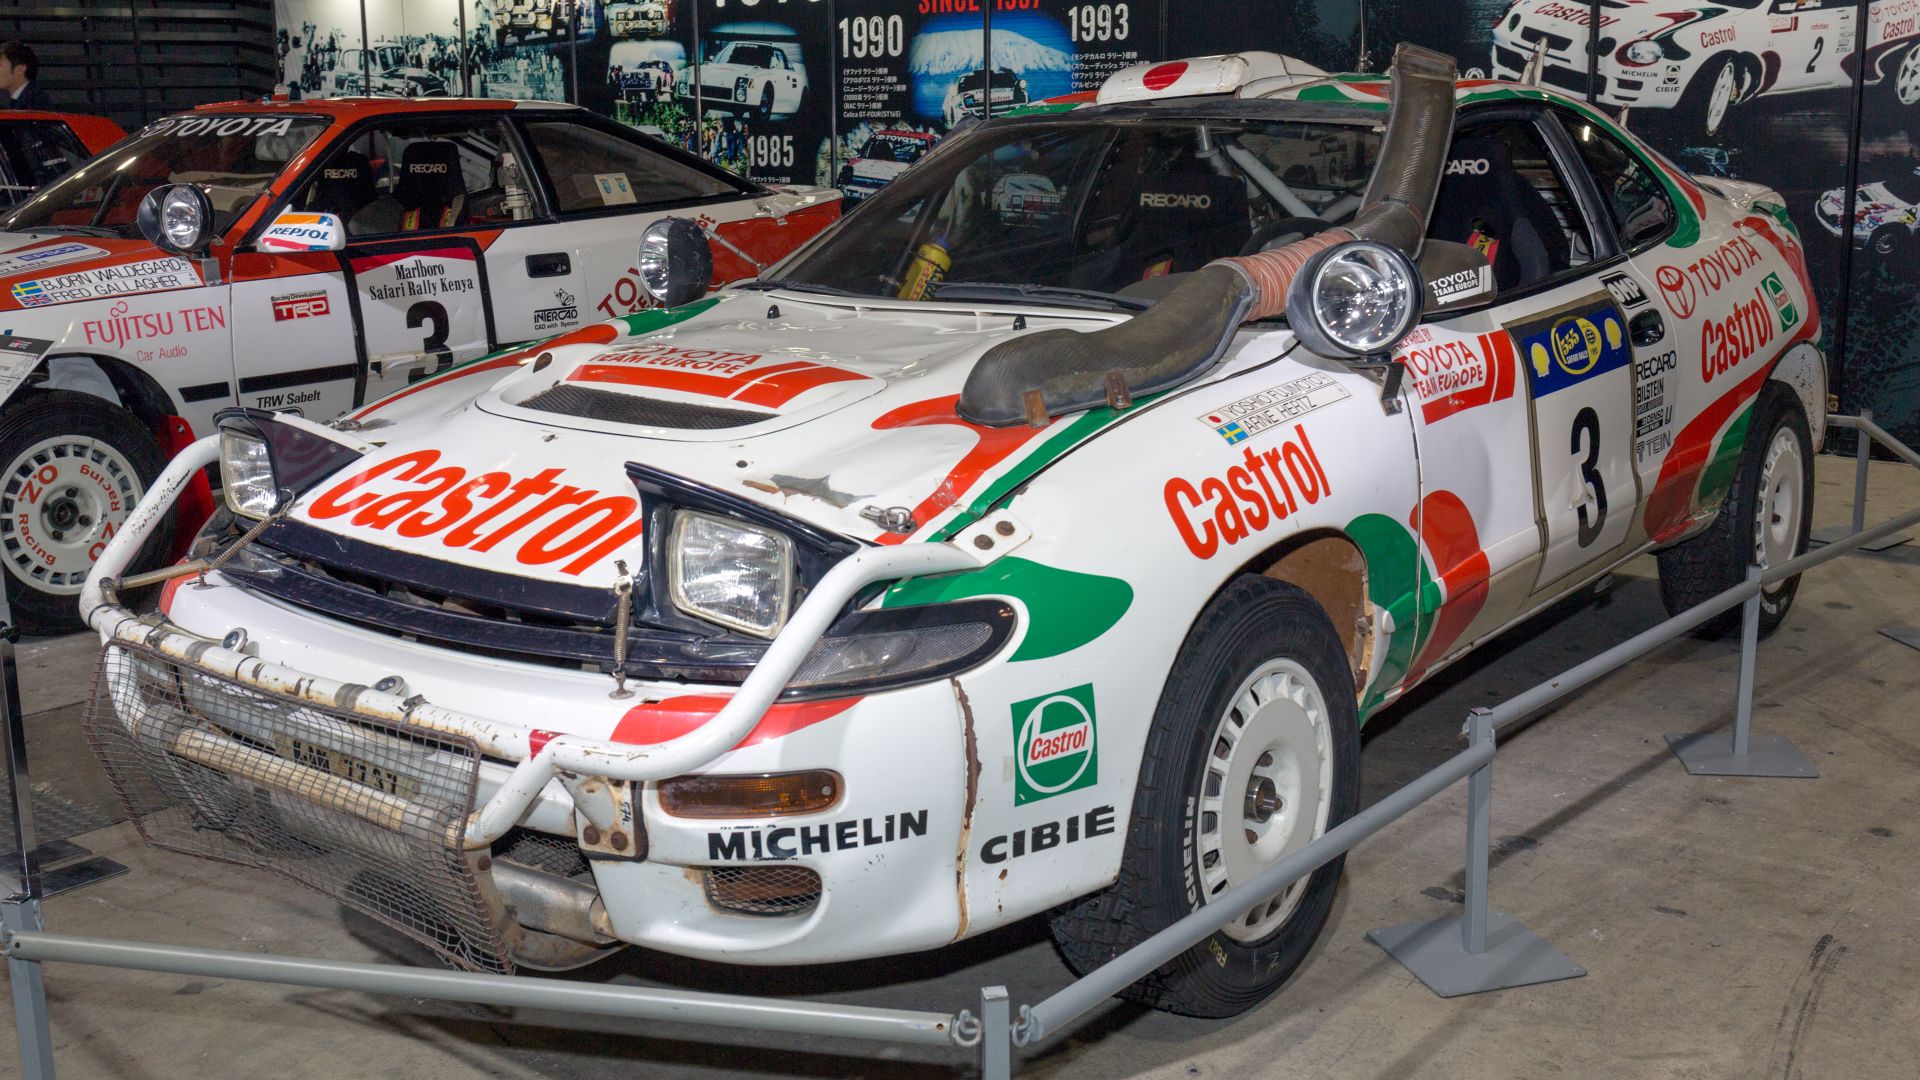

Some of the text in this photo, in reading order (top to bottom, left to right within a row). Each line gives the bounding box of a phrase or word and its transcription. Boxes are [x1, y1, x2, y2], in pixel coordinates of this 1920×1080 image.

[1067, 3, 1130, 42] 1993
[1883, 15, 1915, 40] Castrol
[838, 15, 904, 59] 1990
[1700, 25, 1737, 49] Castrol
[1805, 36, 1824, 74] 2
[1621, 69, 1658, 78] MICHELIN
[166, 118, 293, 137] TOYOTA
[749, 135, 794, 168] 1985
[324, 168, 358, 179] RECARO
[409, 163, 447, 173] RECARO
[1139, 192, 1211, 209] RECARO
[269, 227, 329, 241] REPSOL
[92, 256, 183, 282] WALDEGARD
[395, 259, 445, 280] Marlboro
[1428, 269, 1477, 290] TOYOTA
[1687, 235, 1763, 297] TOYOTA
[50, 287, 91, 302] FRED
[94, 274, 182, 295] GALLAGHER
[290, 289, 327, 301] Development
[369, 278, 474, 301] Safari Rally Kenya
[1433, 278, 1479, 297] TEAM EUROPE
[1608, 277, 1640, 303] OMP
[275, 300, 327, 318] TRD
[534, 308, 578, 323] INTERCAD
[83, 306, 225, 349] FUJITSU TEN
[1701, 286, 1774, 383] Castrol
[137, 344, 188, 362] Car Audio
[406, 300, 453, 385] 3
[1560, 328, 1580, 356] 555
[647, 356, 746, 375] EUROPE
[1393, 340, 1479, 379] TOYOTA
[1636, 350, 1677, 382] RECARO
[1412, 364, 1484, 401] TEAM EUROPE
[1637, 377, 1664, 404] BILSTEIN
[257, 390, 321, 409] TRW Sabelt
[1223, 395, 1273, 419] YOSHIO
[1269, 376, 1324, 401] FUJIMOTO
[1243, 396, 1319, 433] ARNE HERTZ
[79, 464, 121, 512] Racing
[1570, 406, 1608, 548] 3
[1163, 423, 1332, 560] Castrol
[307, 449, 643, 577] Castrol
[19, 513, 57, 566] Racing
[1030, 725, 1088, 761] Castrol
[707, 809, 929, 862] MICHELIN
[1183, 796, 1200, 914] ICHELIN
